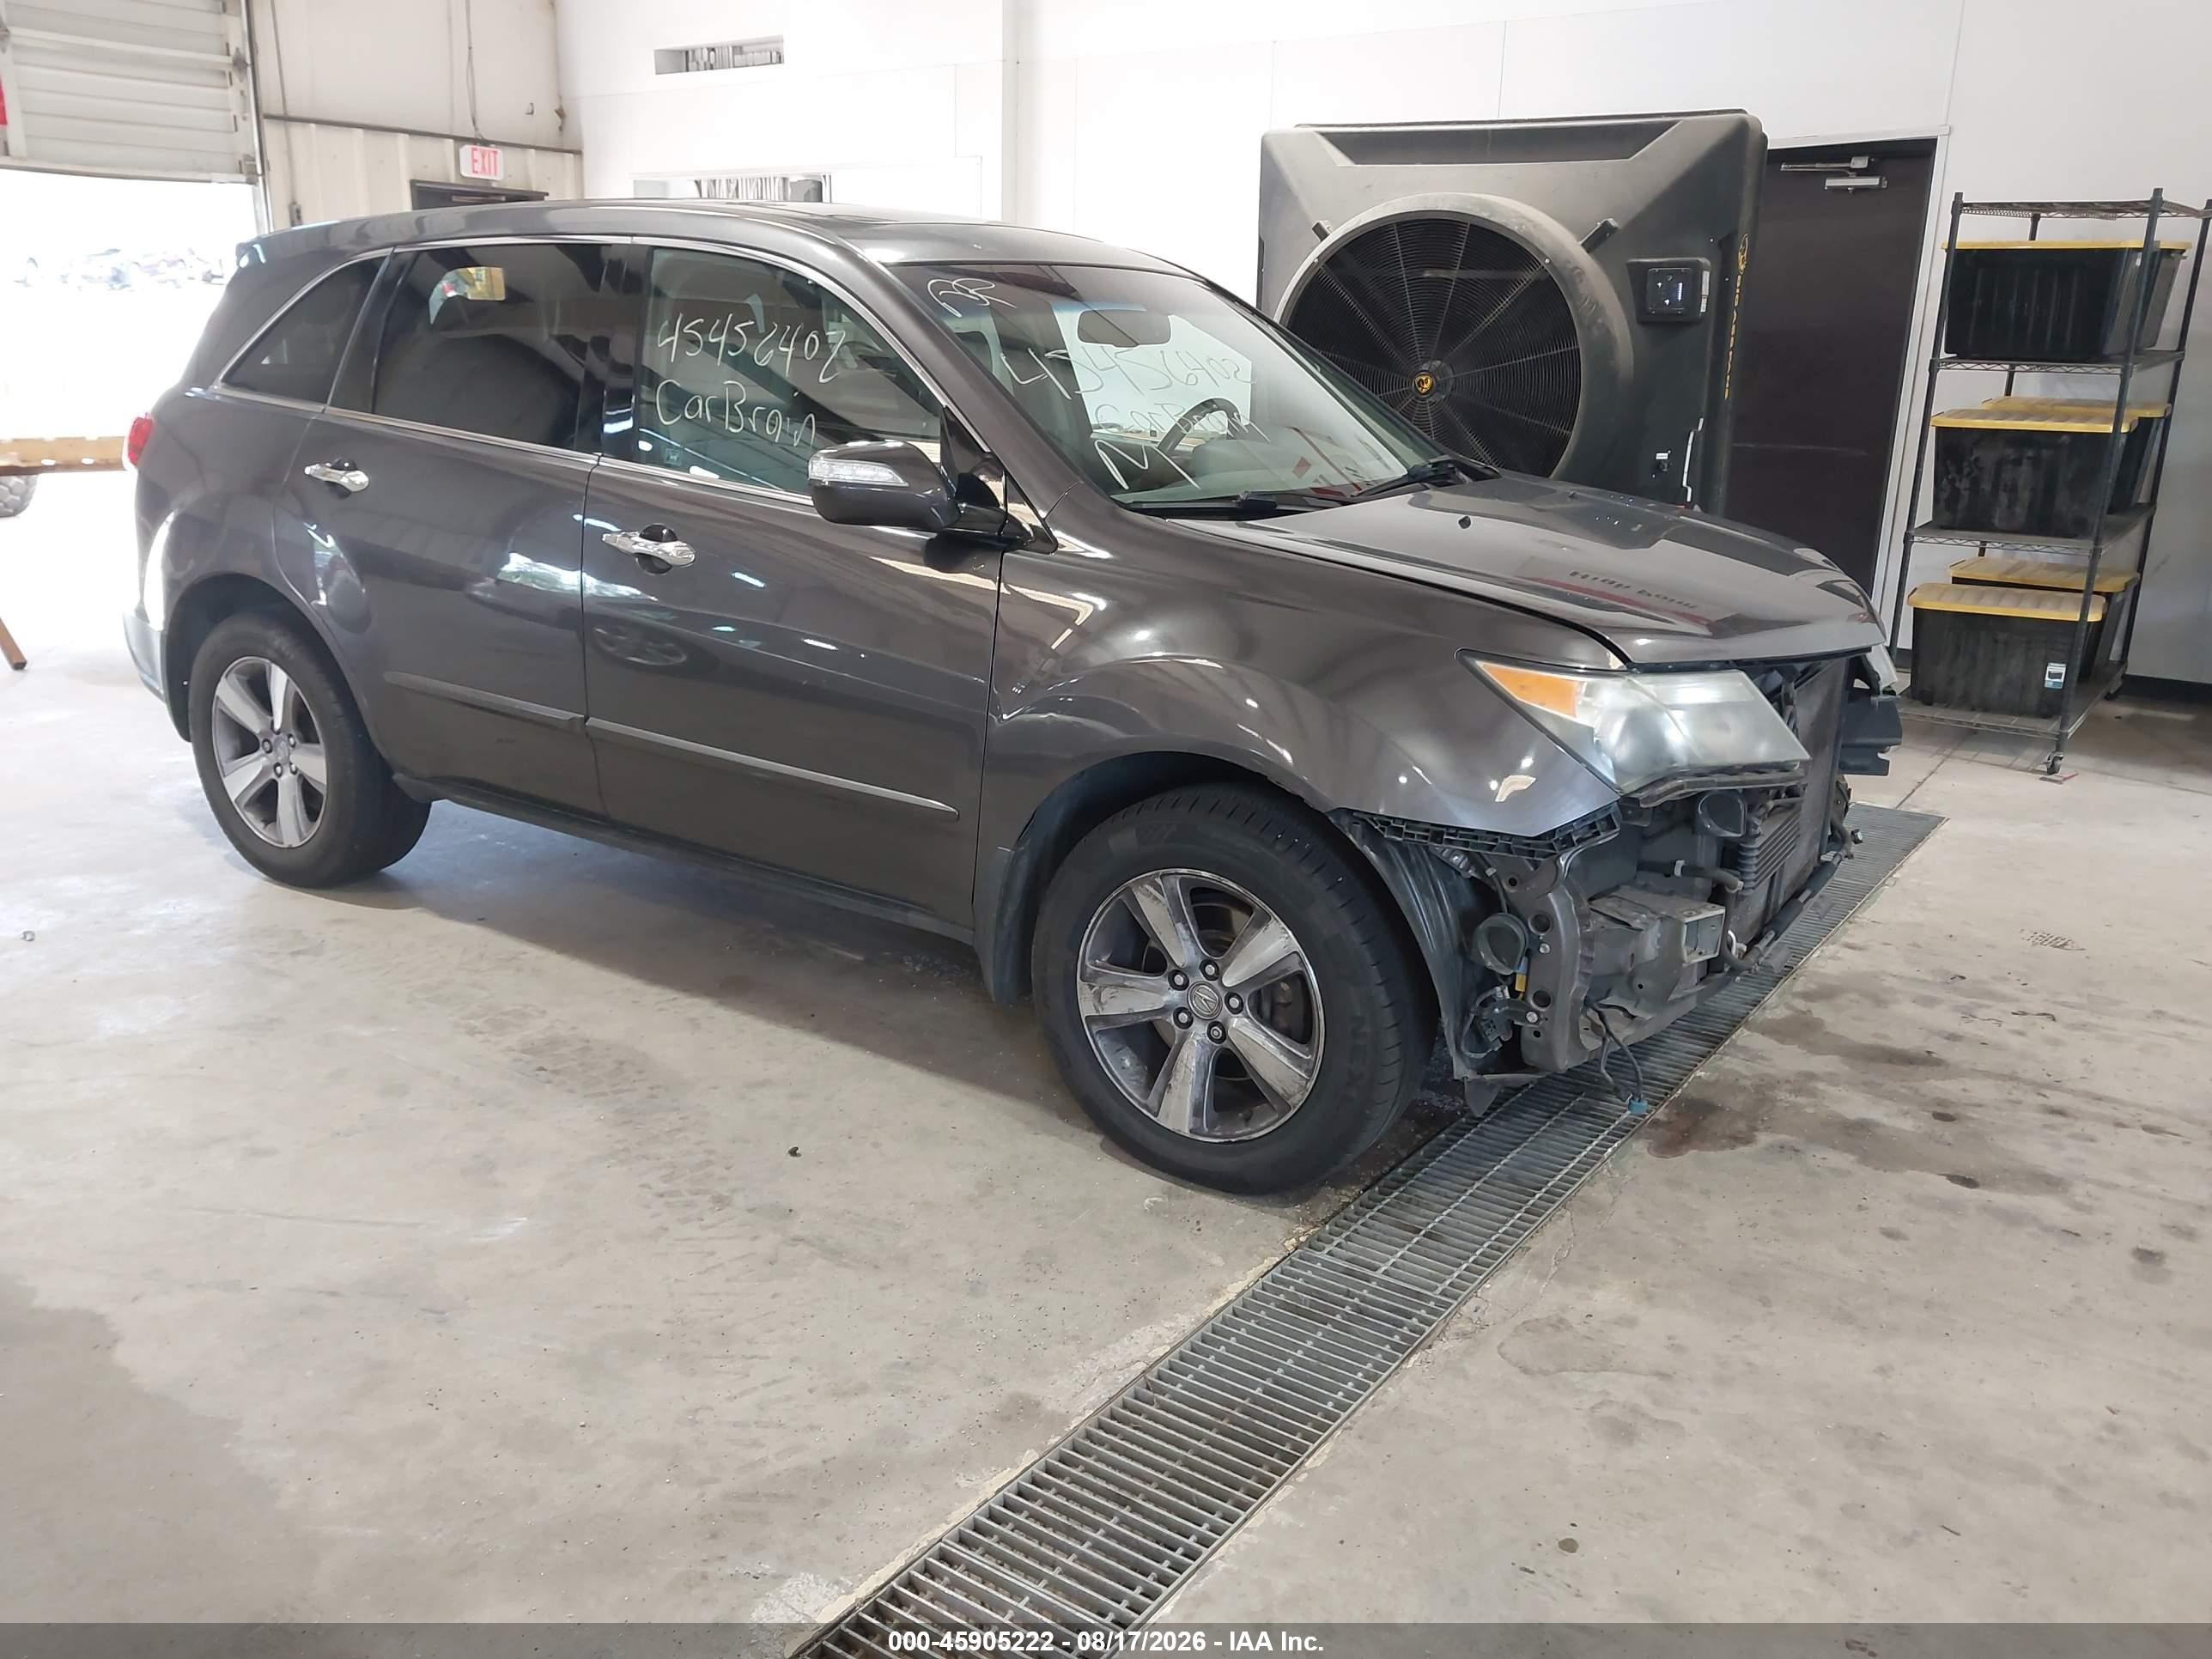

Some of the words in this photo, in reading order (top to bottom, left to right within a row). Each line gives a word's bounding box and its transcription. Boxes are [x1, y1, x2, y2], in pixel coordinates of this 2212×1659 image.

[471, 147, 498, 177] EXIT
[658, 313, 846, 383] 45456402
[1000, 345, 1256, 400] 45456402
[656, 380, 816, 447] CarBrain
